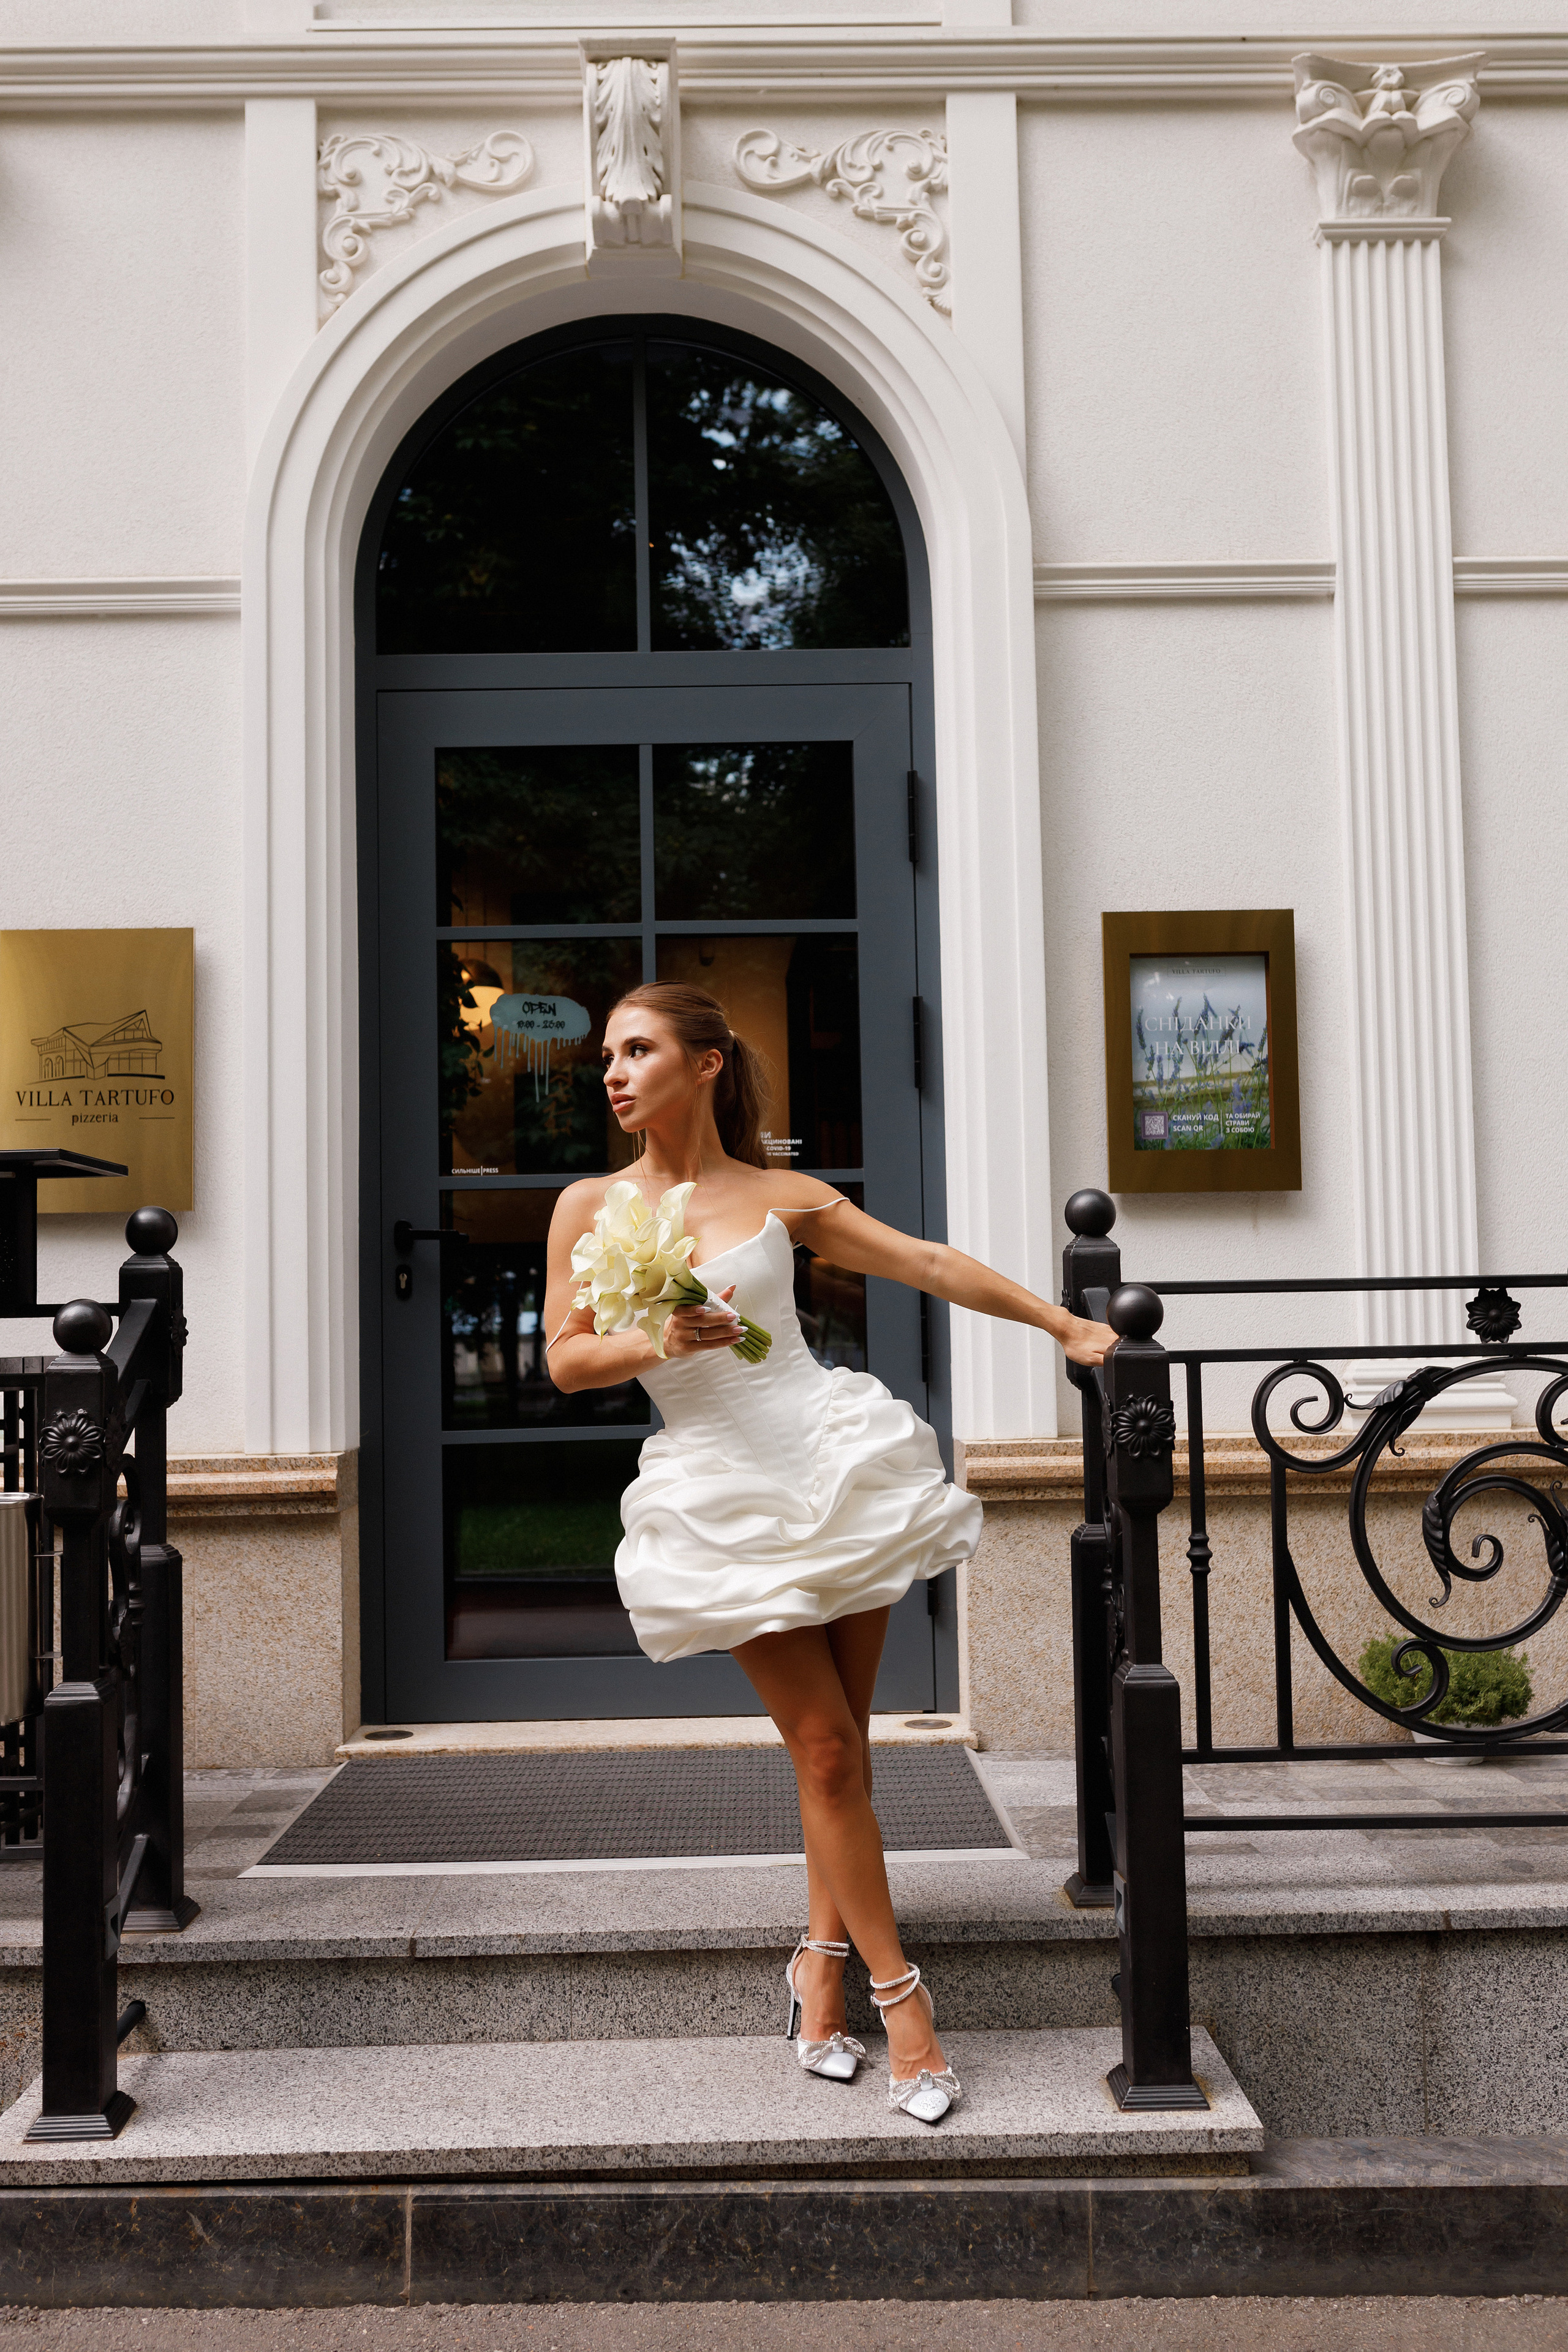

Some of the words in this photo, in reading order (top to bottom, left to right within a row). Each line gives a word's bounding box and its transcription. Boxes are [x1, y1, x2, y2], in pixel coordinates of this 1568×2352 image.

[522, 1001, 557, 1017] OPEN
[1144, 1016, 1251, 1033] СНІДАНКИ
[1155, 1041, 1184, 1055] НА
[1190, 1040, 1240, 1055] ВІЛЛІ
[16, 1090, 72, 1107] VILLA
[79, 1089, 175, 1106] TARTUFO
[72, 1112, 119, 1126] pizzeria
[1172, 1113, 1202, 1121] СКАНУЙ
[1204, 1114, 1219, 1122] КОД
